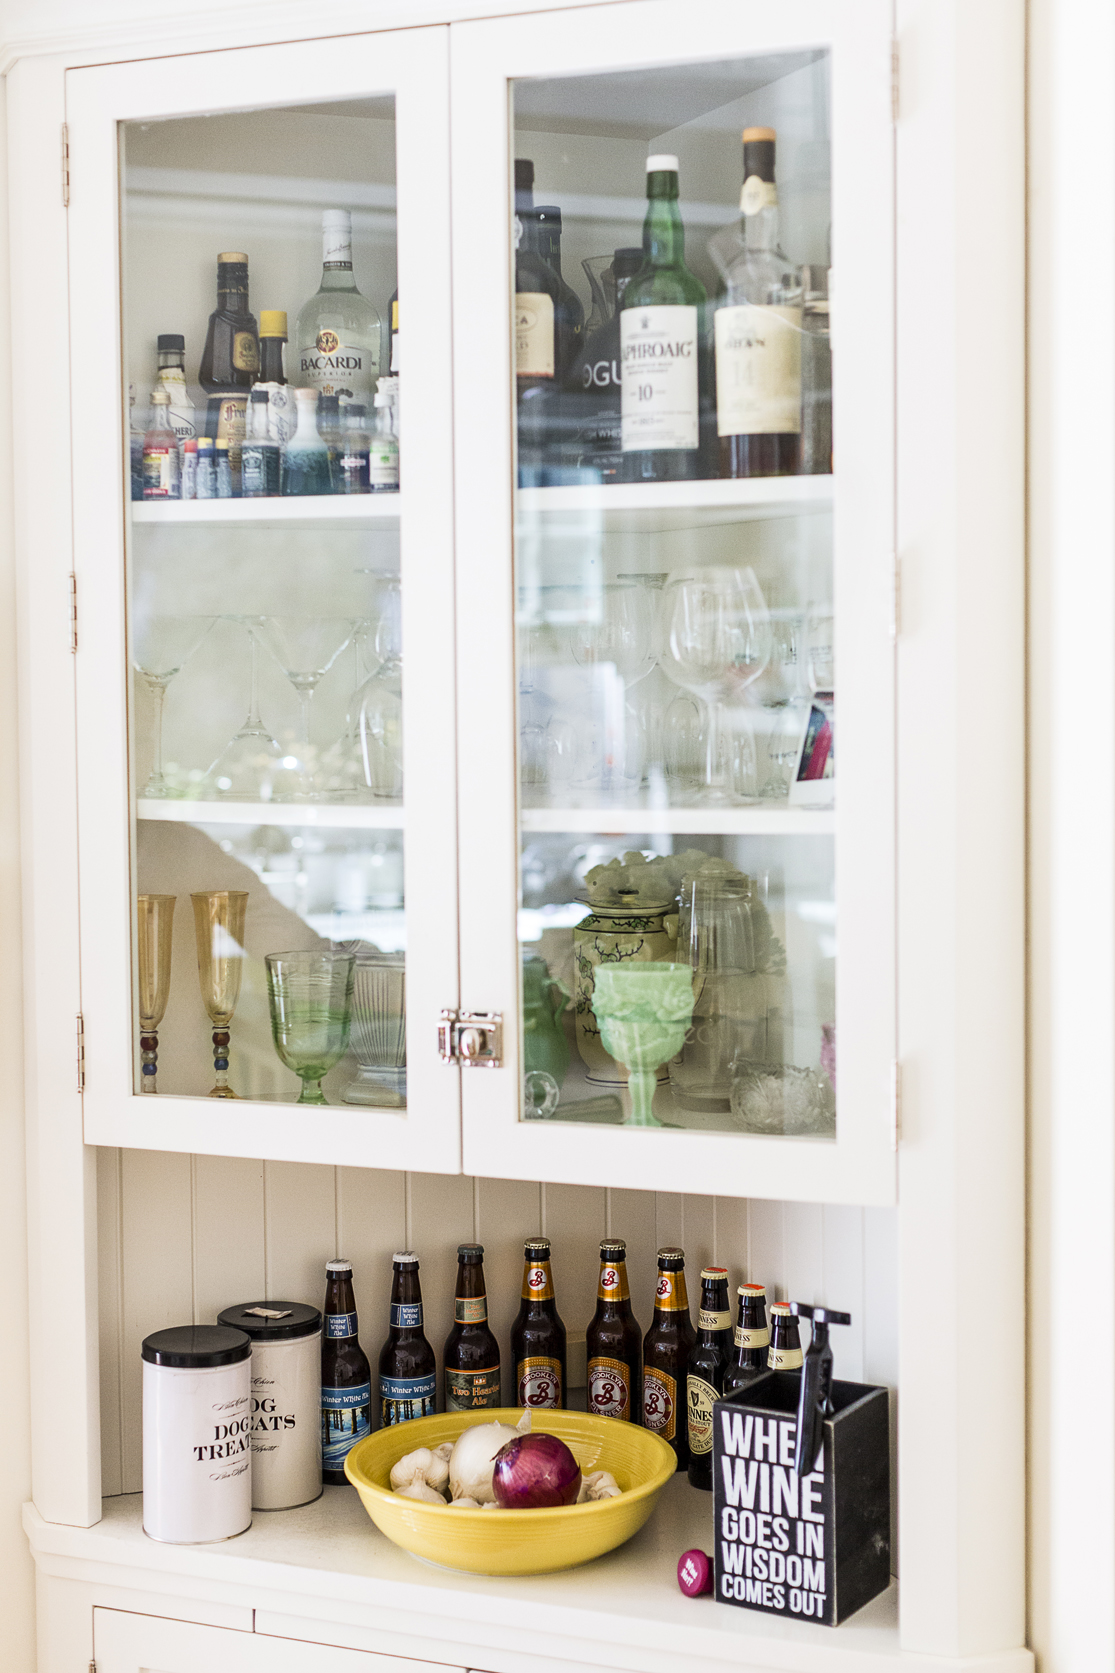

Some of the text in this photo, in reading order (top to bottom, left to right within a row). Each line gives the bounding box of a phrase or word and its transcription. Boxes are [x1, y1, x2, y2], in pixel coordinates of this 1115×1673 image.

[301, 356, 362, 371] BACARDI
[639, 384, 653, 402] 10
[522, 1372, 558, 1385] BROOKLYN
[590, 1372, 624, 1388] BROOKLYN
[390, 1386, 412, 1394] Winter
[451, 1386, 470, 1396] Two
[471, 1397, 487, 1406] Ale
[214, 1416, 249, 1440] DOG
[251, 1414, 296, 1432] ATS
[721, 1411, 824, 1472] WHE
[721, 1455, 825, 1524] WINE
[721, 1506, 824, 1559] GOES IN
[721, 1541, 826, 1593] WISDOM
[721, 1573, 827, 1618] COMES OUT
